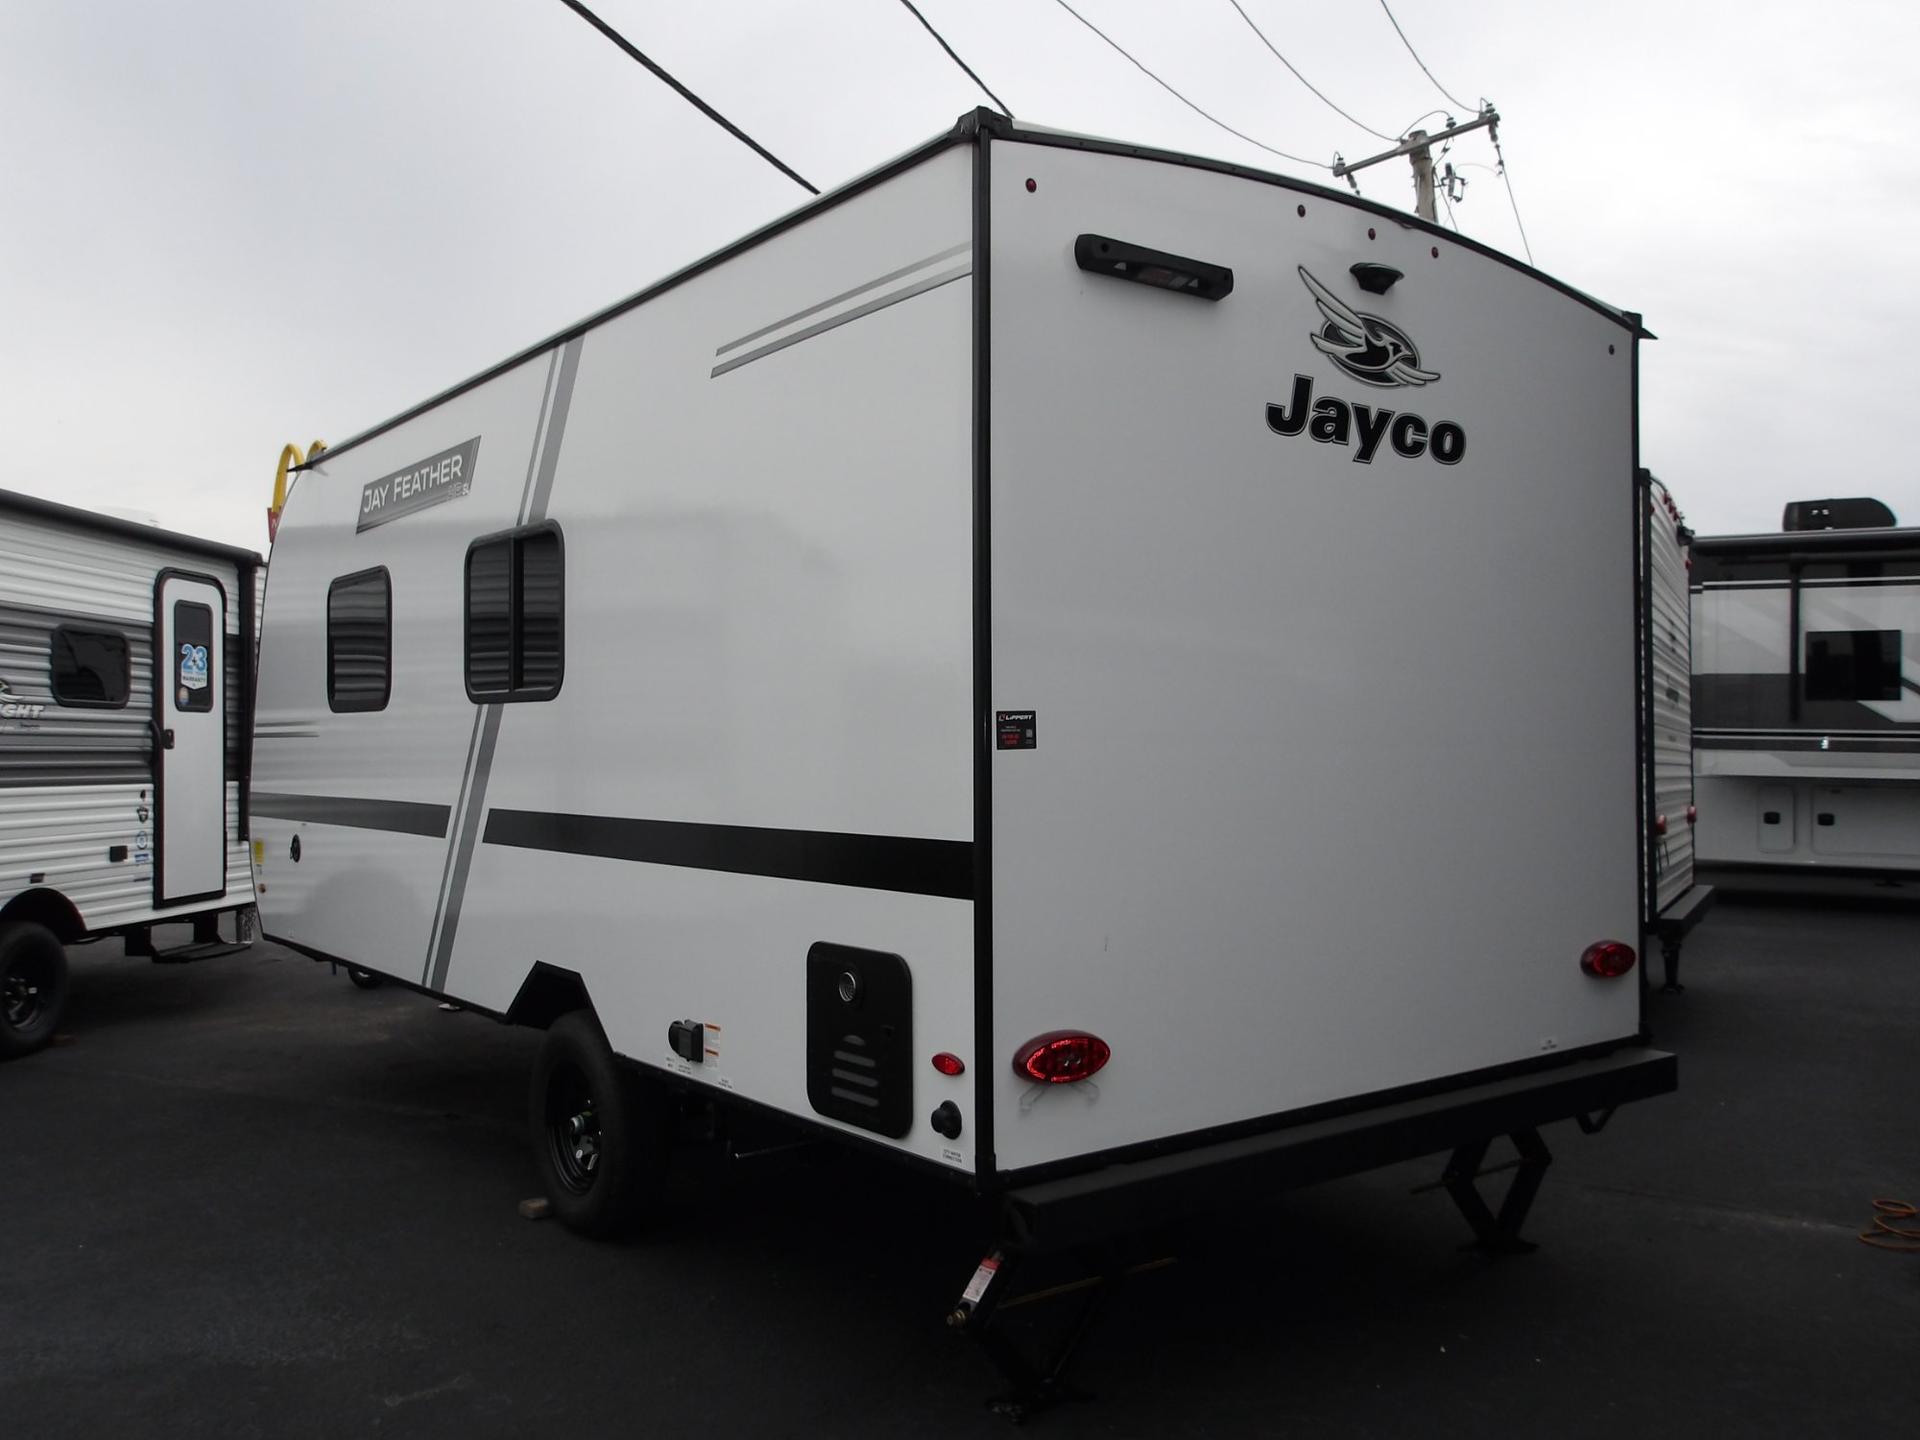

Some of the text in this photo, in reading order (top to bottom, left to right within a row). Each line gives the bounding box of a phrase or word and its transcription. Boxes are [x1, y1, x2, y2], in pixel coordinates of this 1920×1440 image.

[1265, 373, 1467, 465] Jayco
[363, 486, 389, 513] JAY
[393, 454, 463, 502] FEATHER
